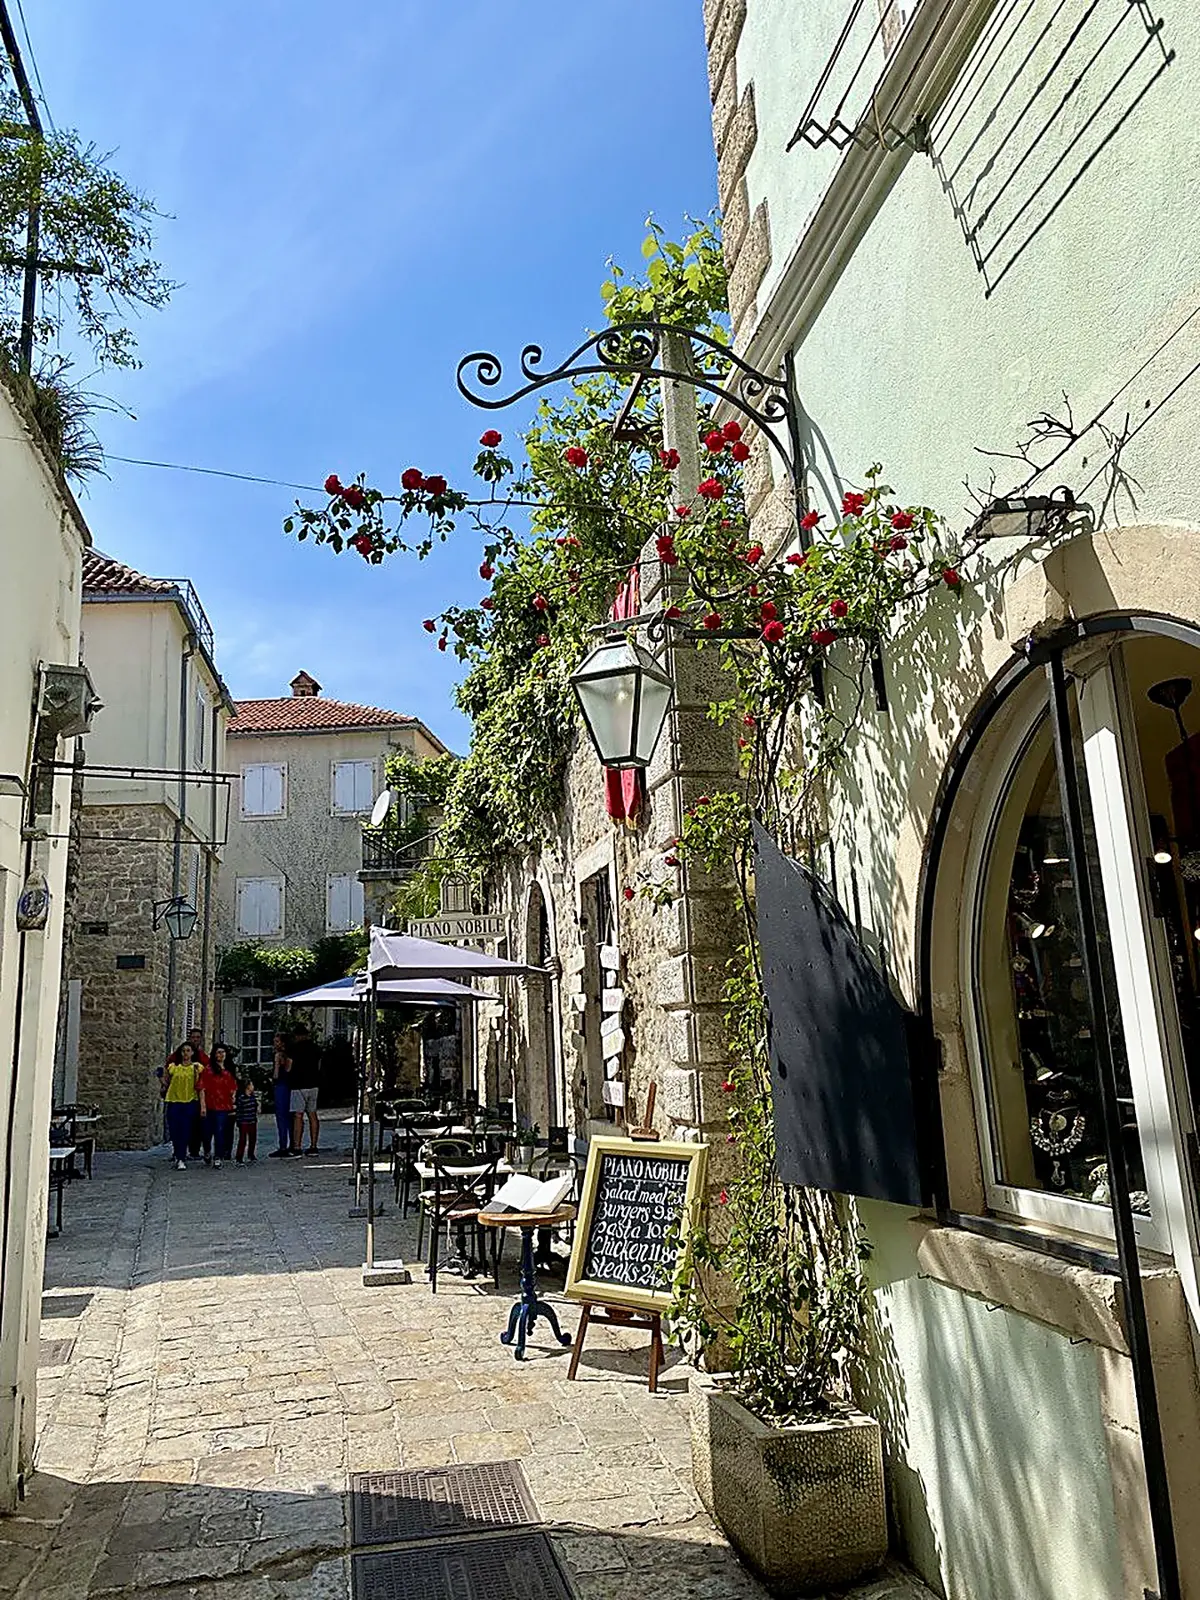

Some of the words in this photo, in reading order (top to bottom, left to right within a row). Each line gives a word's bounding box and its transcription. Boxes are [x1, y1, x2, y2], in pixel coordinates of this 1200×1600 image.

[410, 922, 451, 937] PIANO
[457, 919, 504, 934] NOBILE
[603, 1157, 644, 1178] PIANO
[644, 1161, 689, 1181] NOBILE
[600, 1181, 639, 1202] Salad
[639, 1186, 669, 1205] meal
[599, 1202, 651, 1223] Burgers
[652, 1204, 681, 1221] 9.8
[591, 1236, 647, 1262] Chicken
[585, 1256, 640, 1283] Steaks
